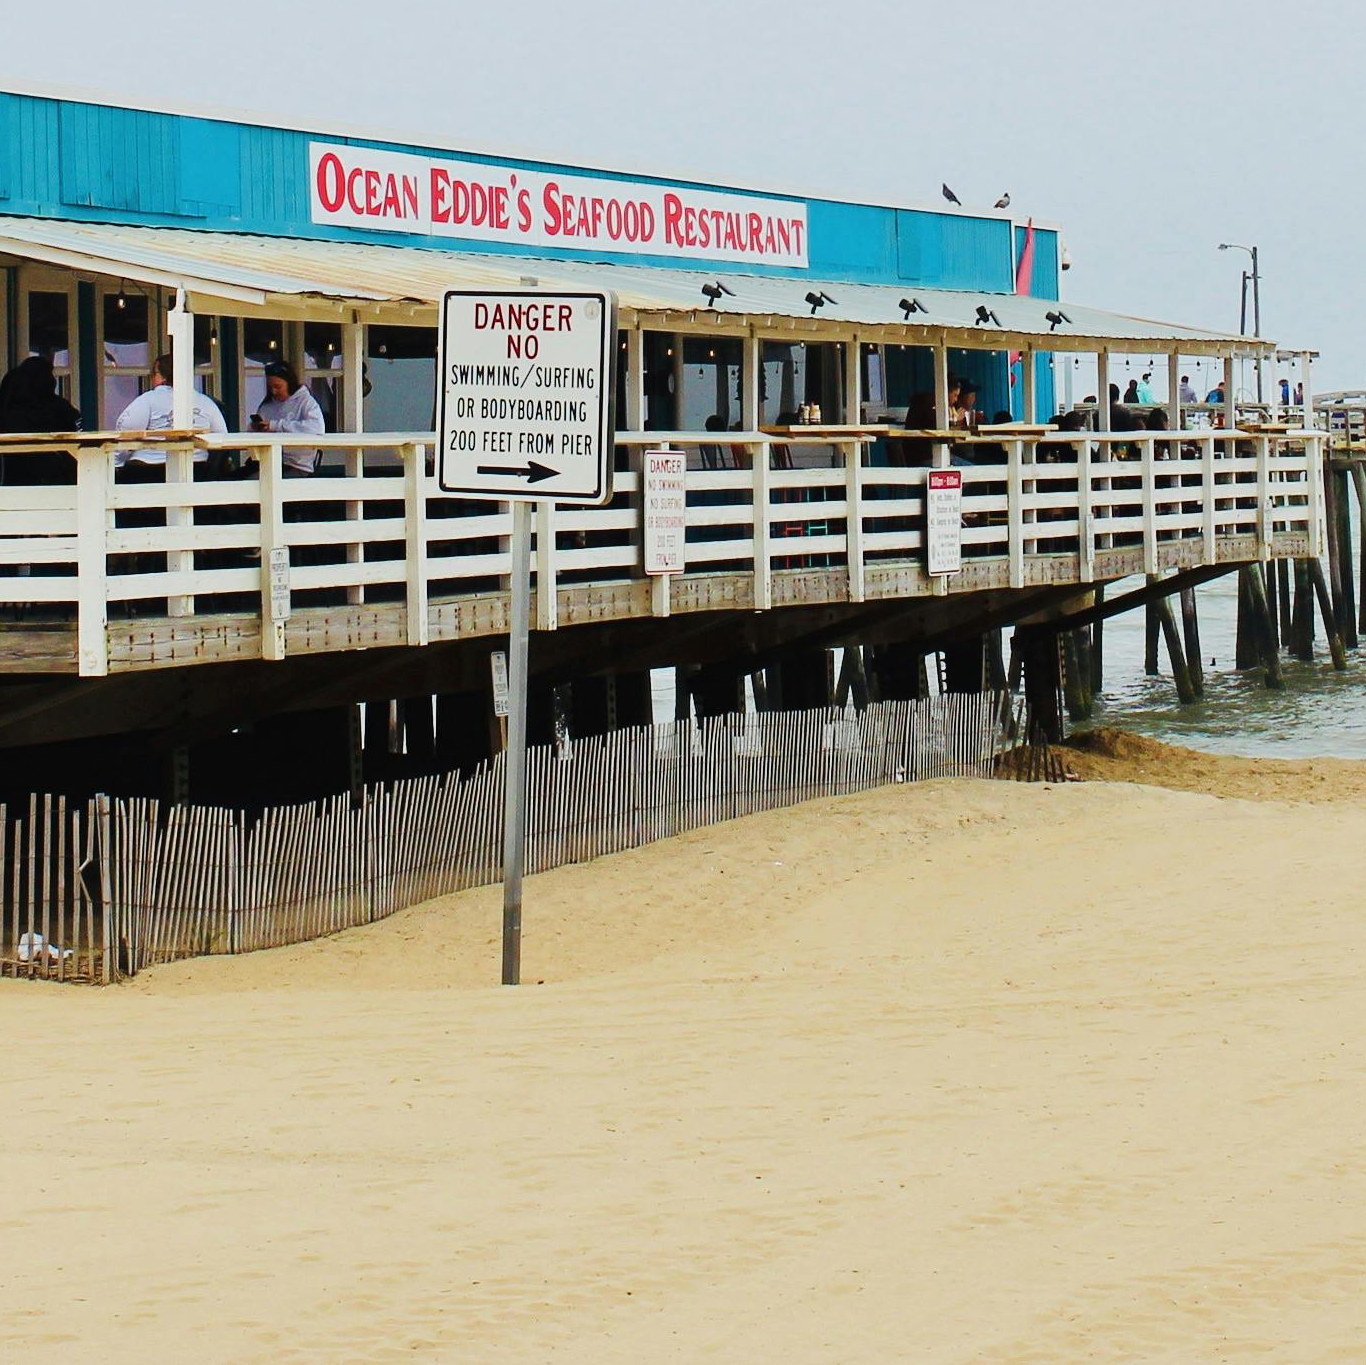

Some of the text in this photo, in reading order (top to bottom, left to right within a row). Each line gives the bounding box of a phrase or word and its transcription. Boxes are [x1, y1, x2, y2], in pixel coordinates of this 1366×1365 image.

[316, 152, 804, 256] OCEAN EDDIE'S SEAFOOD RESTAURANT
[474, 303, 573, 332] DANGER
[507, 334, 539, 360] NO
[451, 363, 595, 389] SWIMMING/SURFING
[457, 397, 587, 422] OR BODYBOARDING
[450, 430, 592, 456] 200 FEET FROM PIER
[650, 459, 682, 474] DANGER
